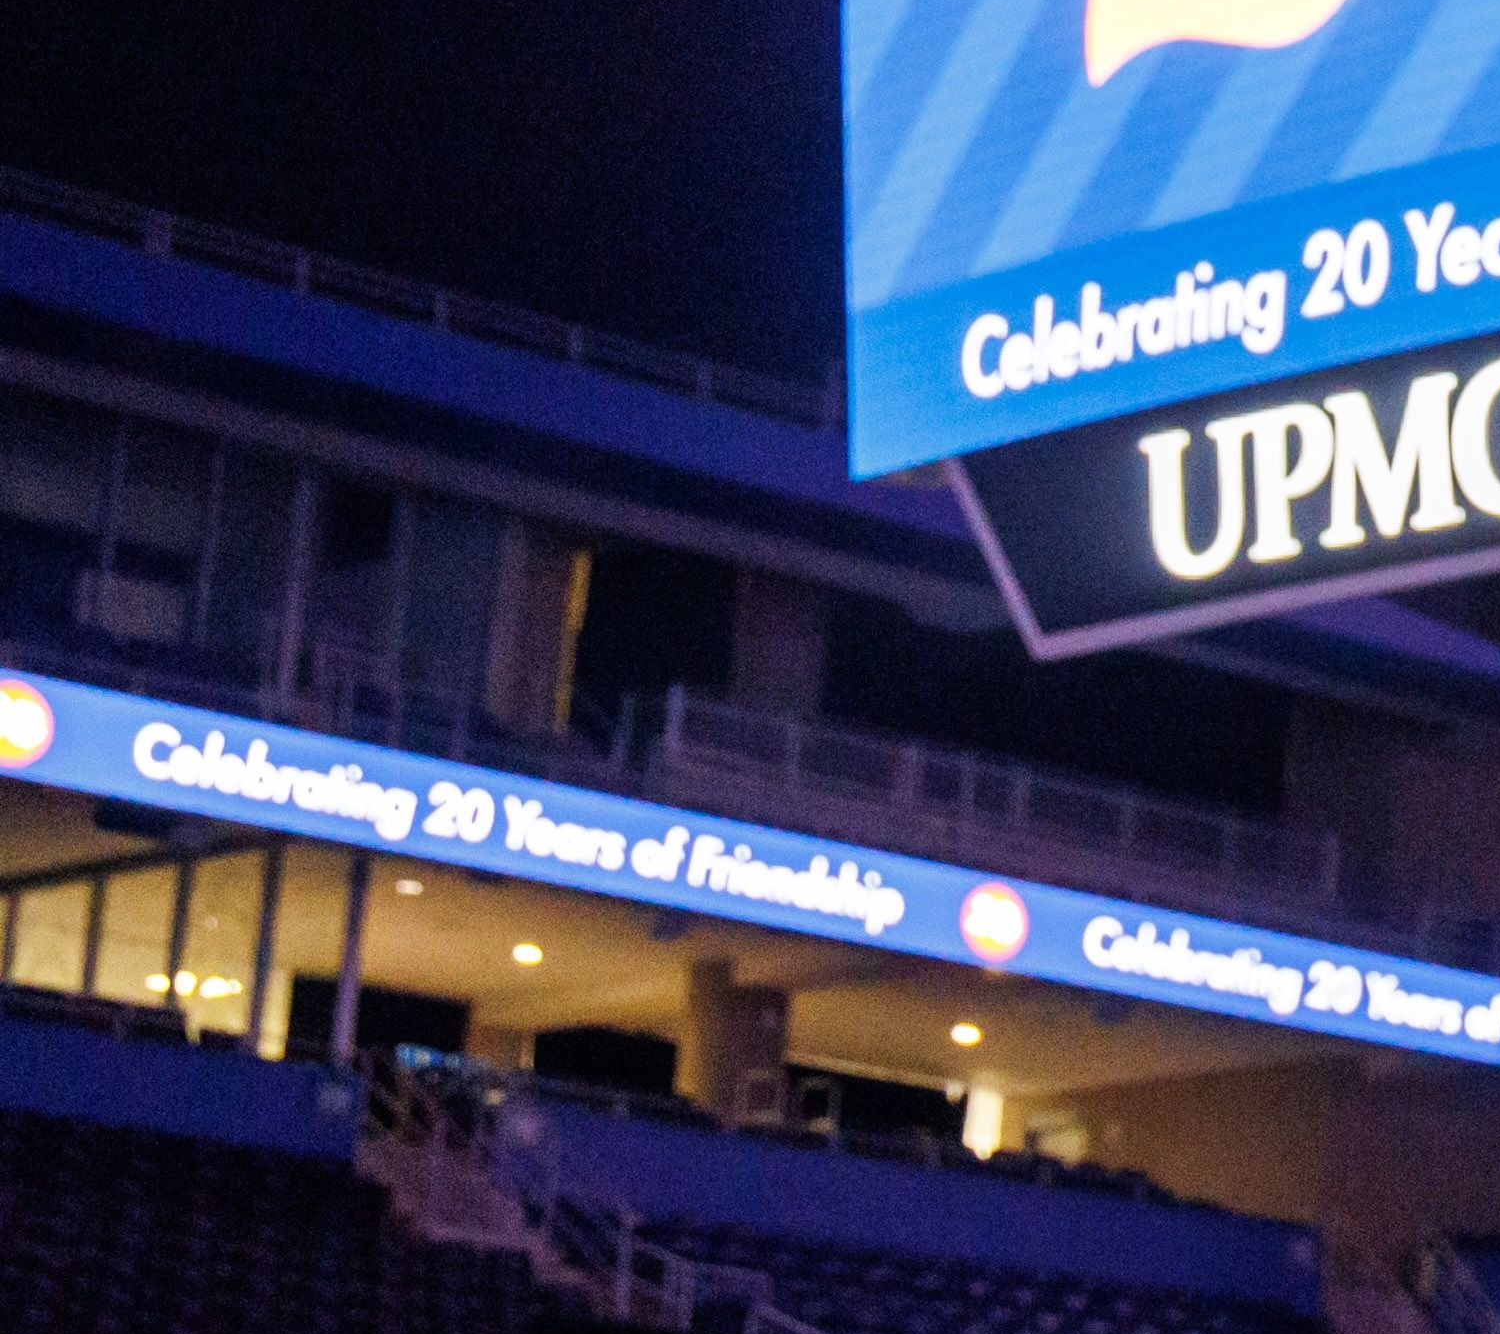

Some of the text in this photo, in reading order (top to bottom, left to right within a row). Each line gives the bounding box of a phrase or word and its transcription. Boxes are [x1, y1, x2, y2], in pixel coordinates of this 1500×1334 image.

[960, 262, 1287, 399] Celebrating
[1301, 219, 1388, 320] 20
[133, 721, 905, 936] Celebrating 20 Years of Friendship
[1083, 914, 1304, 1016] Celebrating
[1303, 959, 1363, 1014] 20
[1365, 971, 1464, 1038] Years
